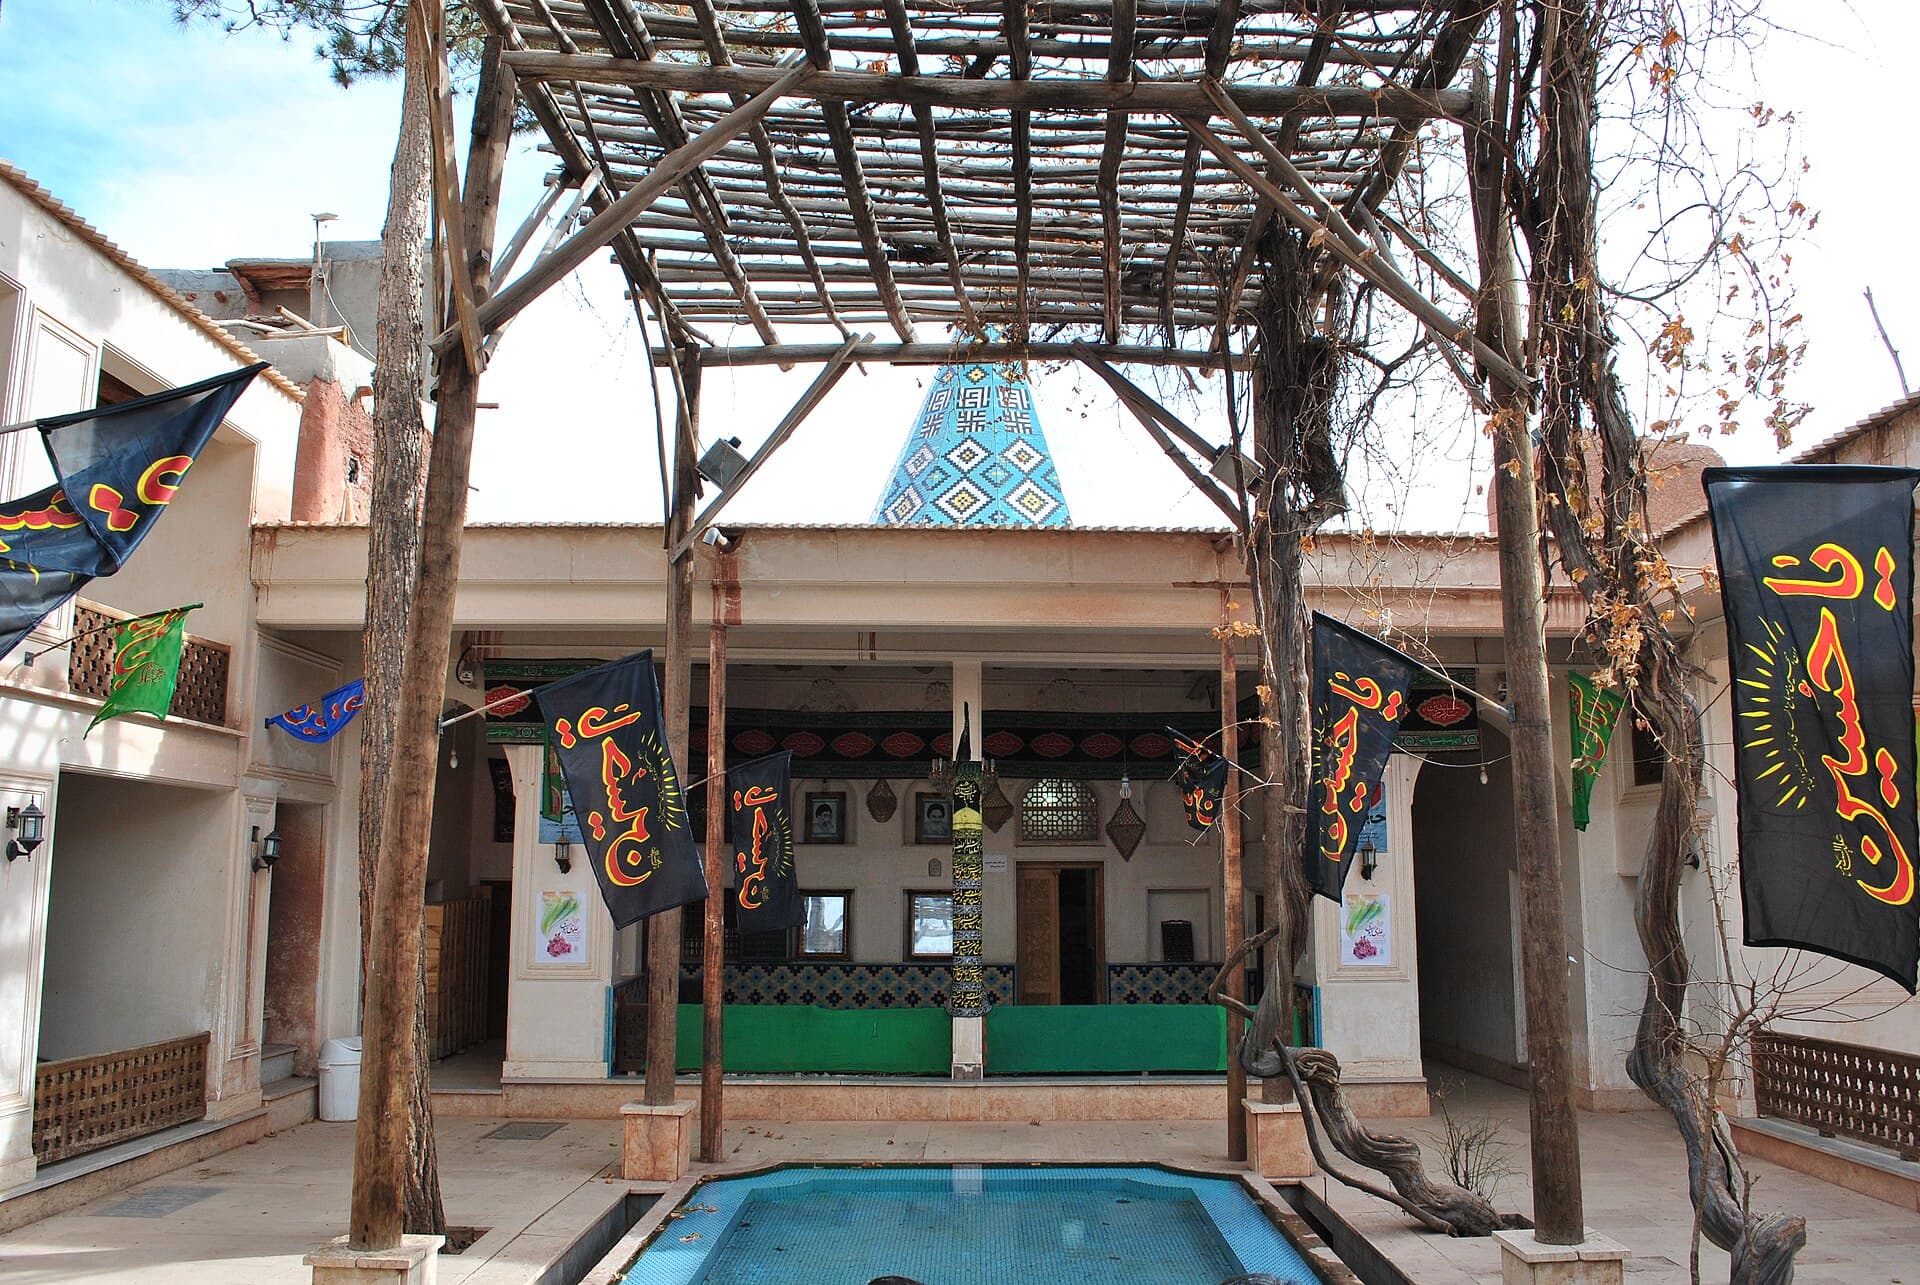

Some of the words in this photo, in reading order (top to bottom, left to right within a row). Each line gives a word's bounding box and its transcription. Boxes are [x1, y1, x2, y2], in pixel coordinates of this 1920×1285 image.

[1762, 542, 1897, 612] یا
[1328, 671, 1403, 722] یا
[1806, 606, 1915, 906] حسین
